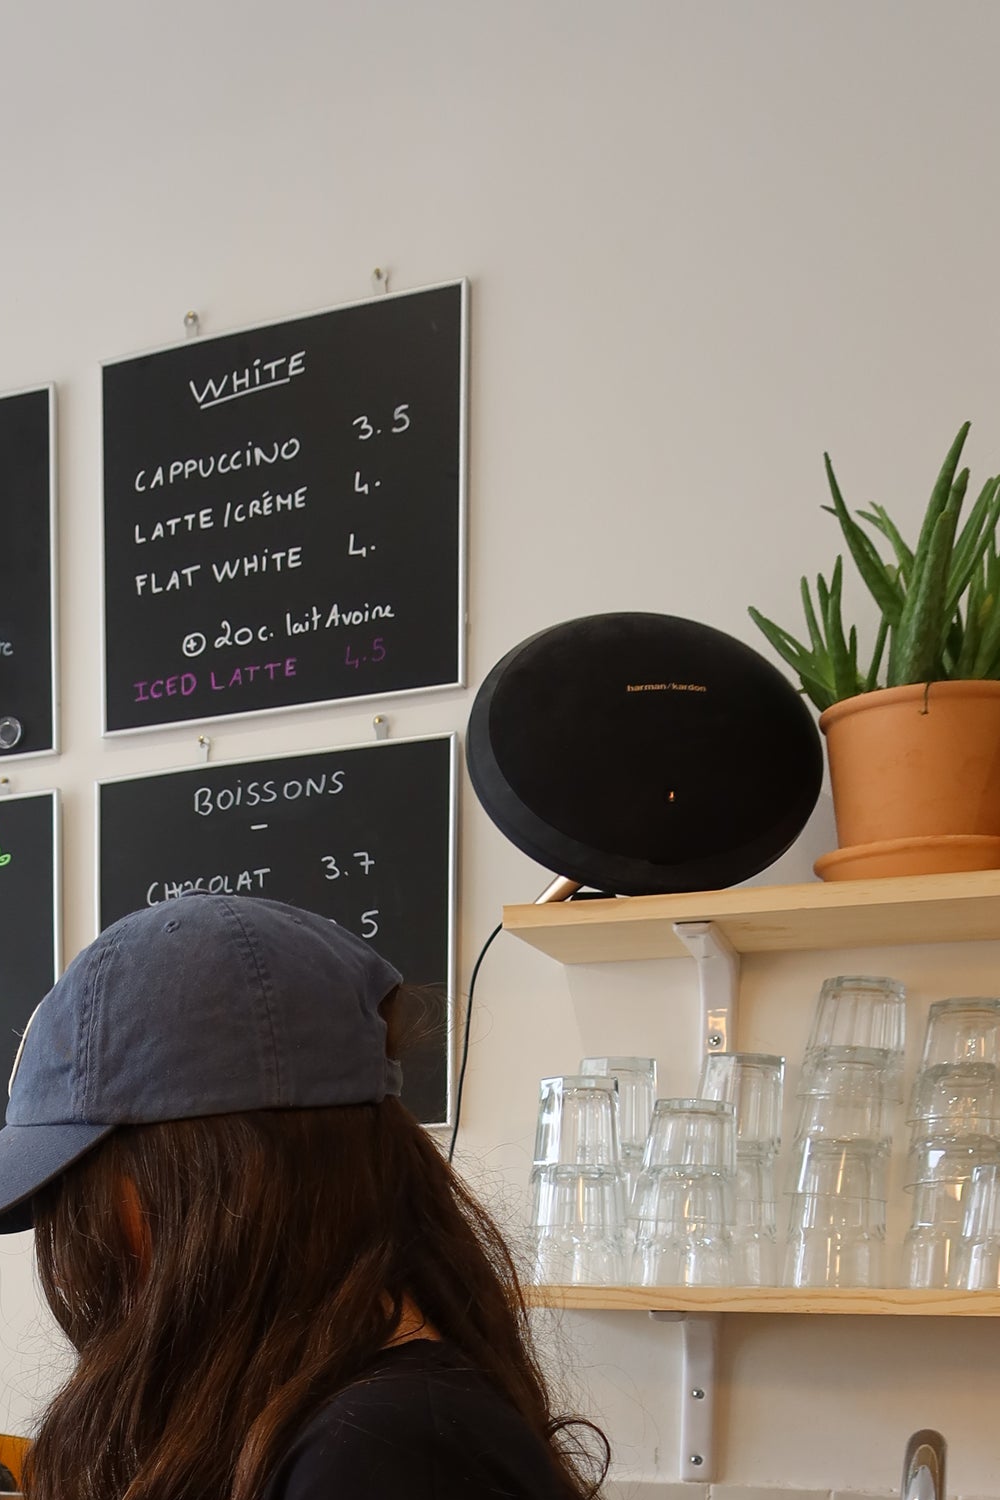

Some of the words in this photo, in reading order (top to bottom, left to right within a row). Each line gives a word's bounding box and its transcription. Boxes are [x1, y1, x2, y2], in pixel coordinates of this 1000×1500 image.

[189, 350, 306, 405] WHITE
[352, 404, 410, 440] 3.5
[134, 438, 300, 491] CAPPUCCINO
[135, 564, 201, 596] FLAT
[212, 546, 302, 583] WHITE
[285, 606, 322, 636] lait
[134, 672, 197, 702] ICED
[210, 657, 297, 691] LATTE
[193, 770, 345, 816] BOISSONS
[321, 851, 375, 880] 3.7
